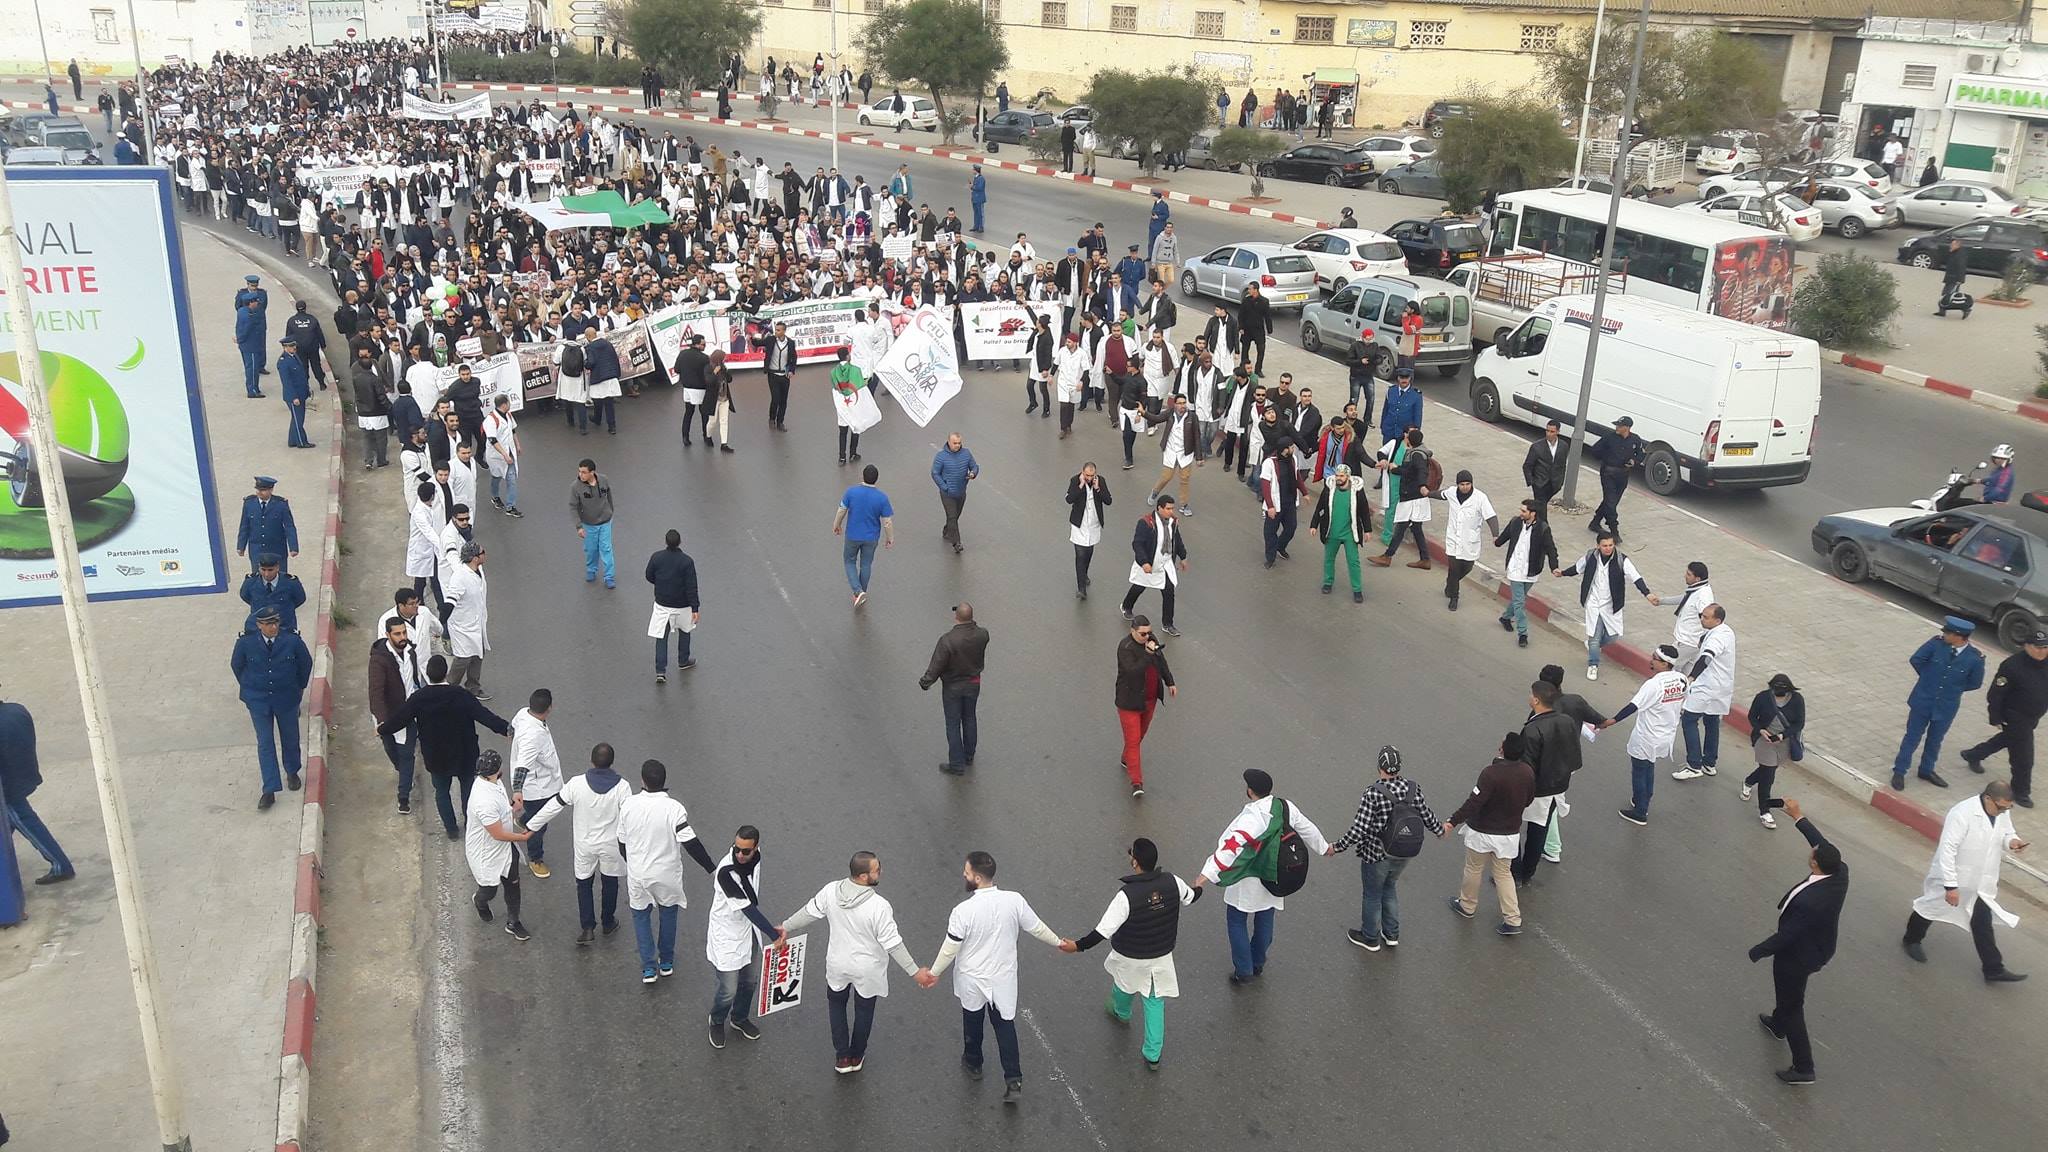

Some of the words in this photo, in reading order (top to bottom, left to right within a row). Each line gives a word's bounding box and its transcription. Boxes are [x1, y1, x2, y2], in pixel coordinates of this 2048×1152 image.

[1955, 85, 2048, 109] PHARMA
[16, 222, 93, 255] NAL
[0, 266, 98, 294] RITE
[0, 309, 102, 333] EMENT
[1664, 686, 1681, 695] NON
[776, 944, 790, 984] NON
